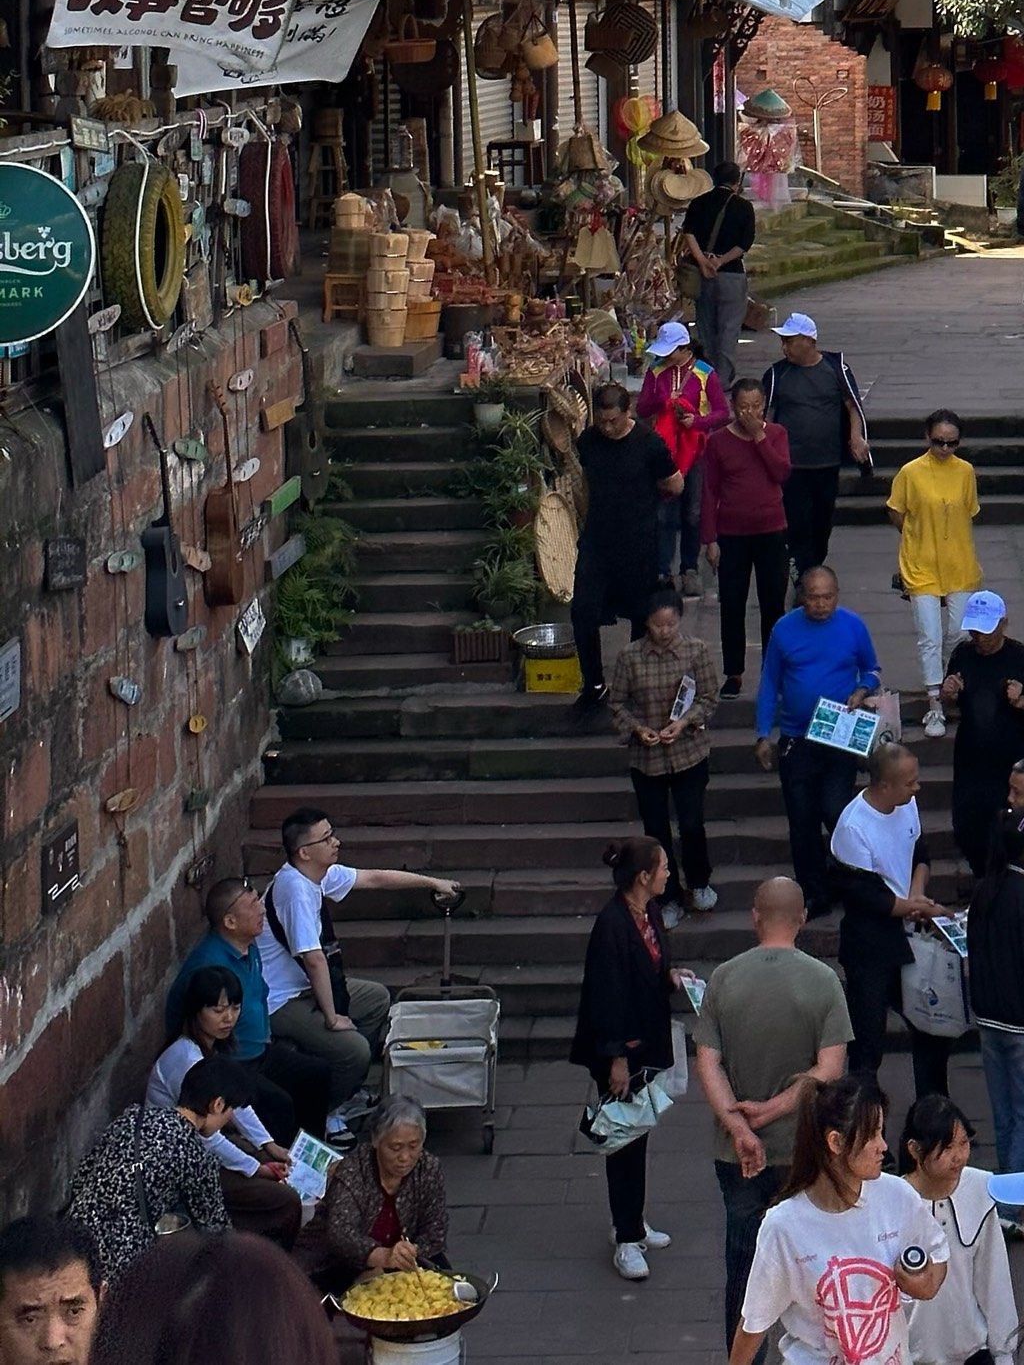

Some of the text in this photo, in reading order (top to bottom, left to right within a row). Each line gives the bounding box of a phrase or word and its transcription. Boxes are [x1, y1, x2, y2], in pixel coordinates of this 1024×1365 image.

[161, 30, 180, 39] CAN
[184, 32, 212, 45] BRING
[215, 39, 265, 59] HAPPINESS
